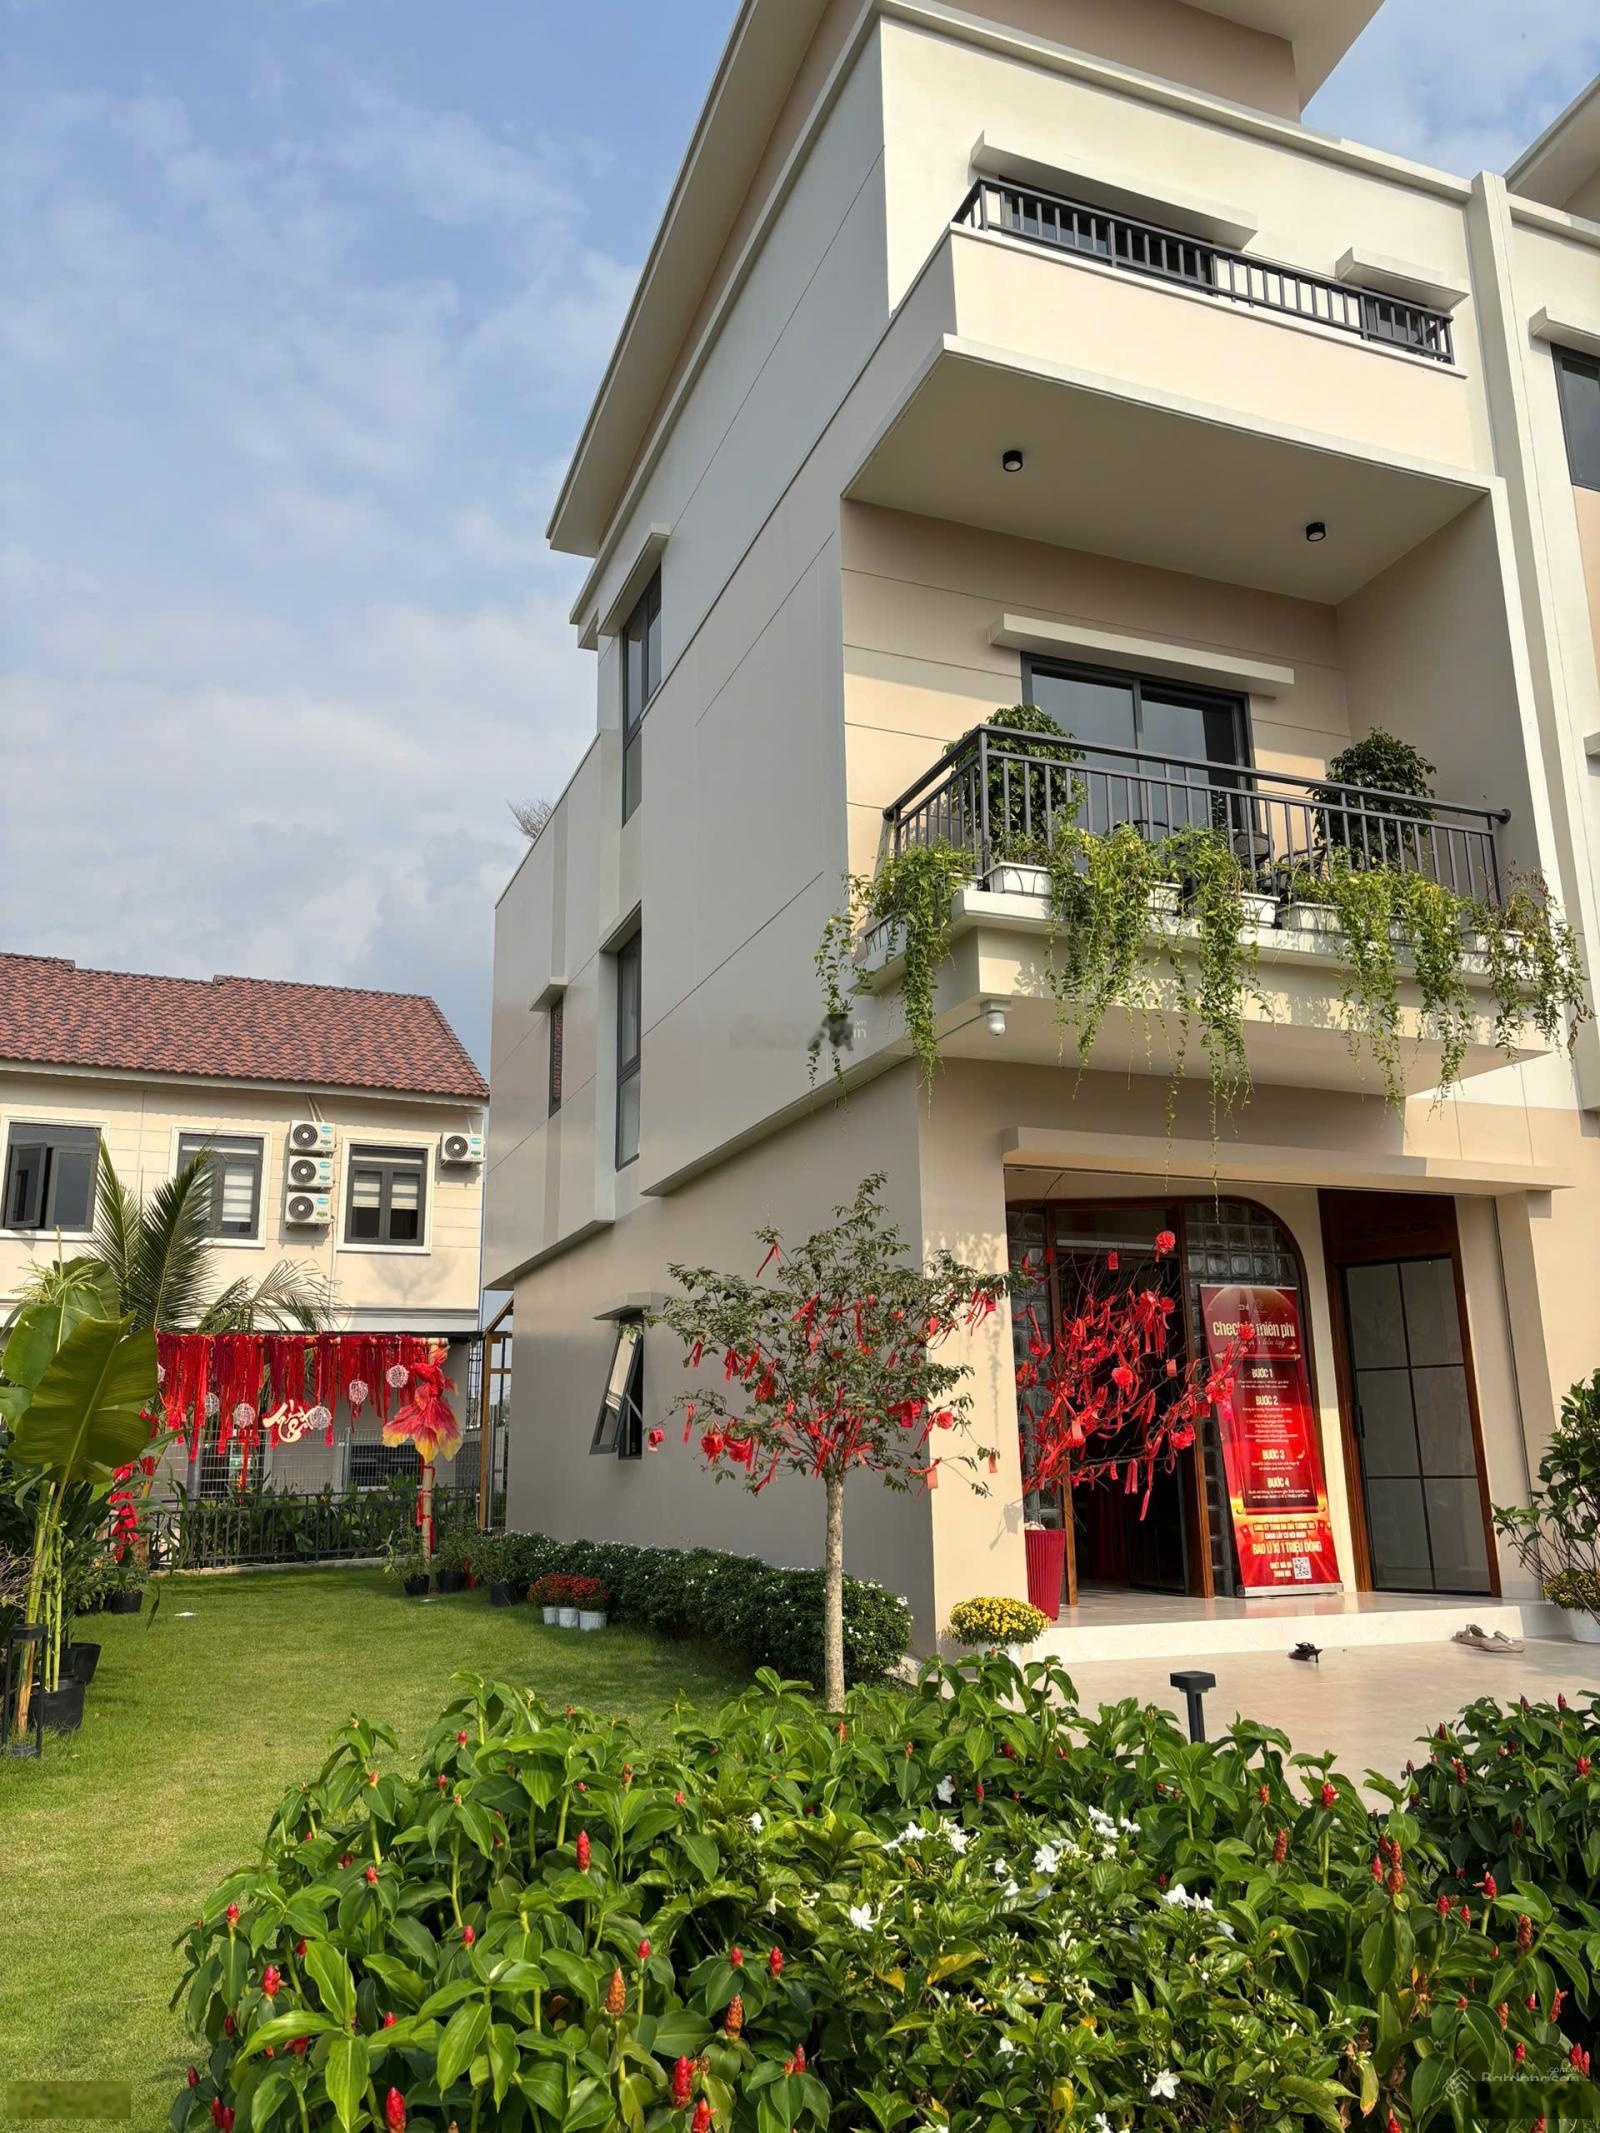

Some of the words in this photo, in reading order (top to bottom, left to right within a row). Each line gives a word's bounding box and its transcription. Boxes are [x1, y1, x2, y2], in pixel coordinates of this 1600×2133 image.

[1273, 1396, 1279, 1405] 2
[1280, 1449, 1285, 1460] 3
[1285, 1477, 1290, 1488] 4
